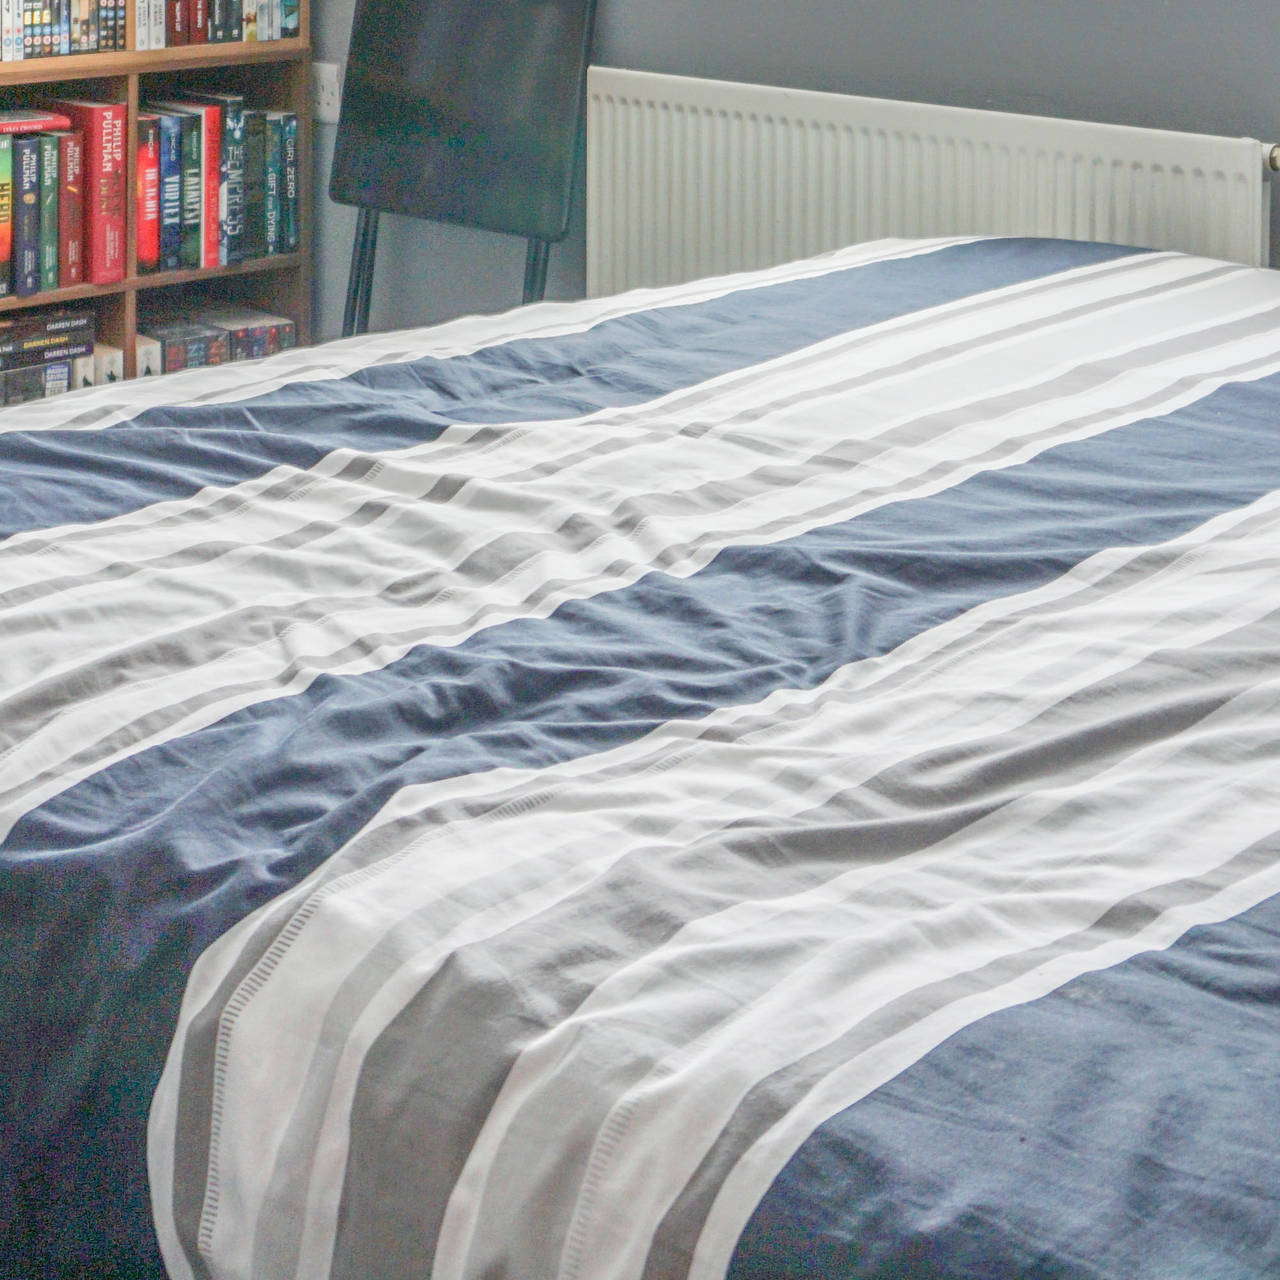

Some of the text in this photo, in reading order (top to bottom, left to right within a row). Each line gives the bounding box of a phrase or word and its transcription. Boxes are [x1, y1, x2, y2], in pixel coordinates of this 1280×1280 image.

[102, 111, 112, 172] PULLMAN
[113, 120, 122, 161] PHILIP
[164, 175, 180, 225] VORTEX
[184, 168, 200, 225] CATALYST
[227, 160, 243, 235] EMPRESS
[268, 173, 276, 195] GIFT
[287, 167, 295, 198] ZERO
[267, 211, 275, 242] DYING
[47, 319, 87, 331] DARREN DASH
[44, 347, 86, 359] DARREN DASH
